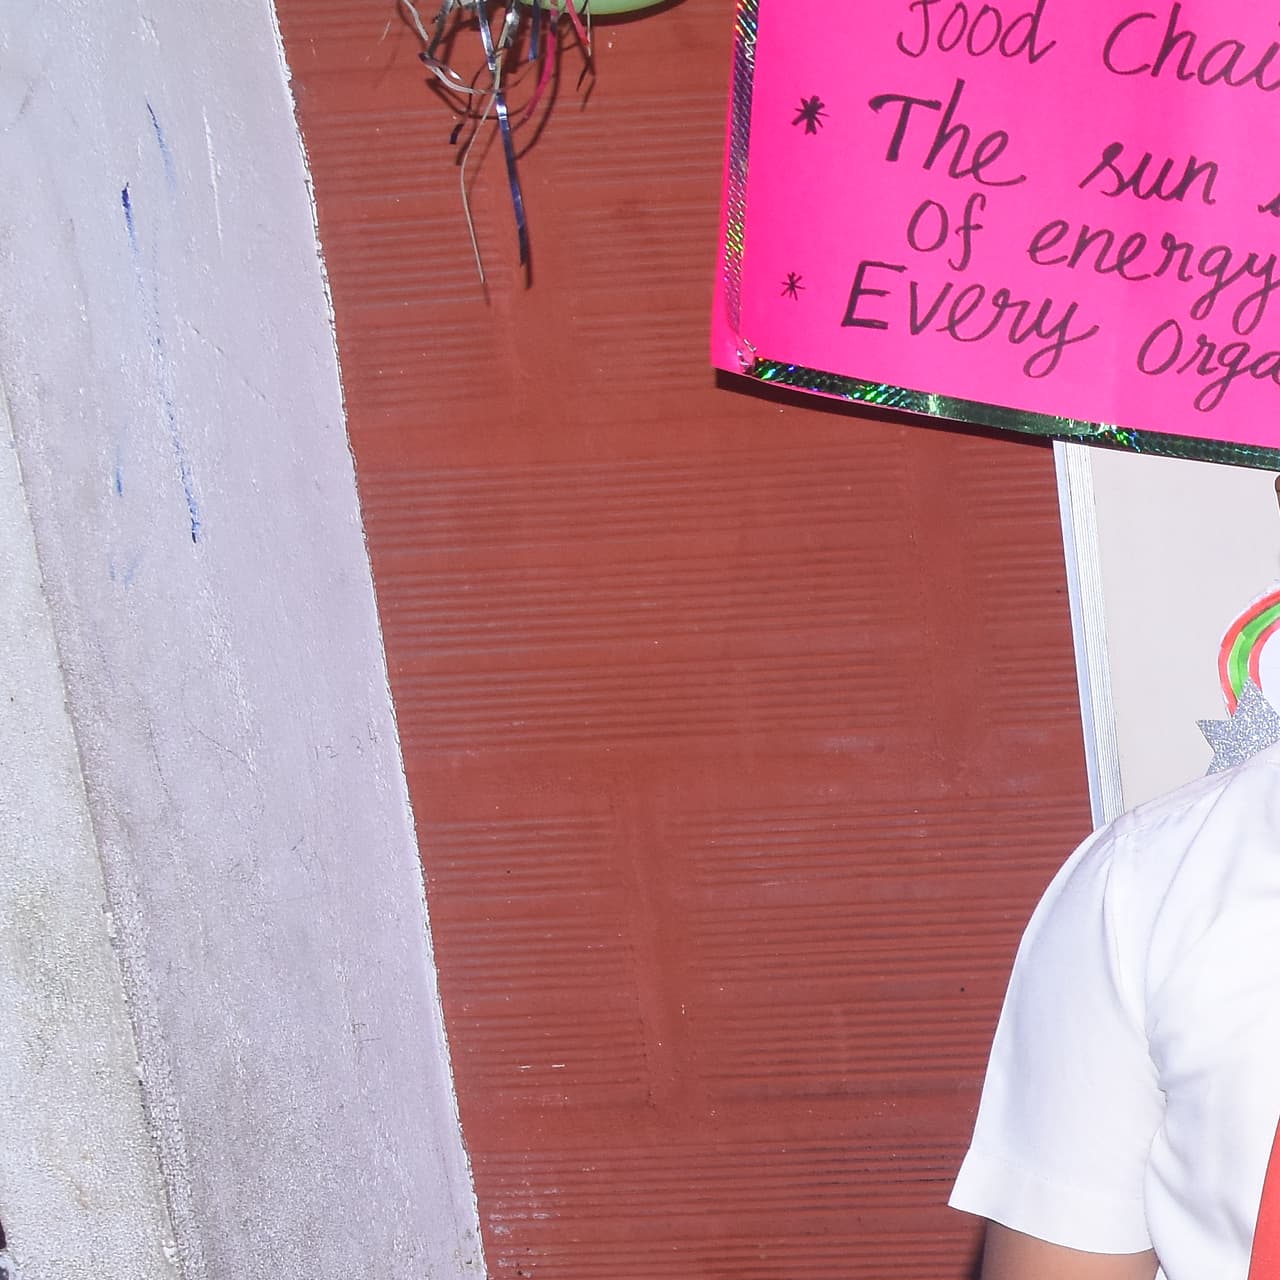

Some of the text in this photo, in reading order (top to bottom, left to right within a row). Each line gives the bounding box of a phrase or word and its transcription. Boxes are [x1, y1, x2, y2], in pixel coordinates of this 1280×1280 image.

[868, 79, 1027, 187] The
[1078, 142, 1218, 205] sun
[841, 261, 1099, 378] Every
